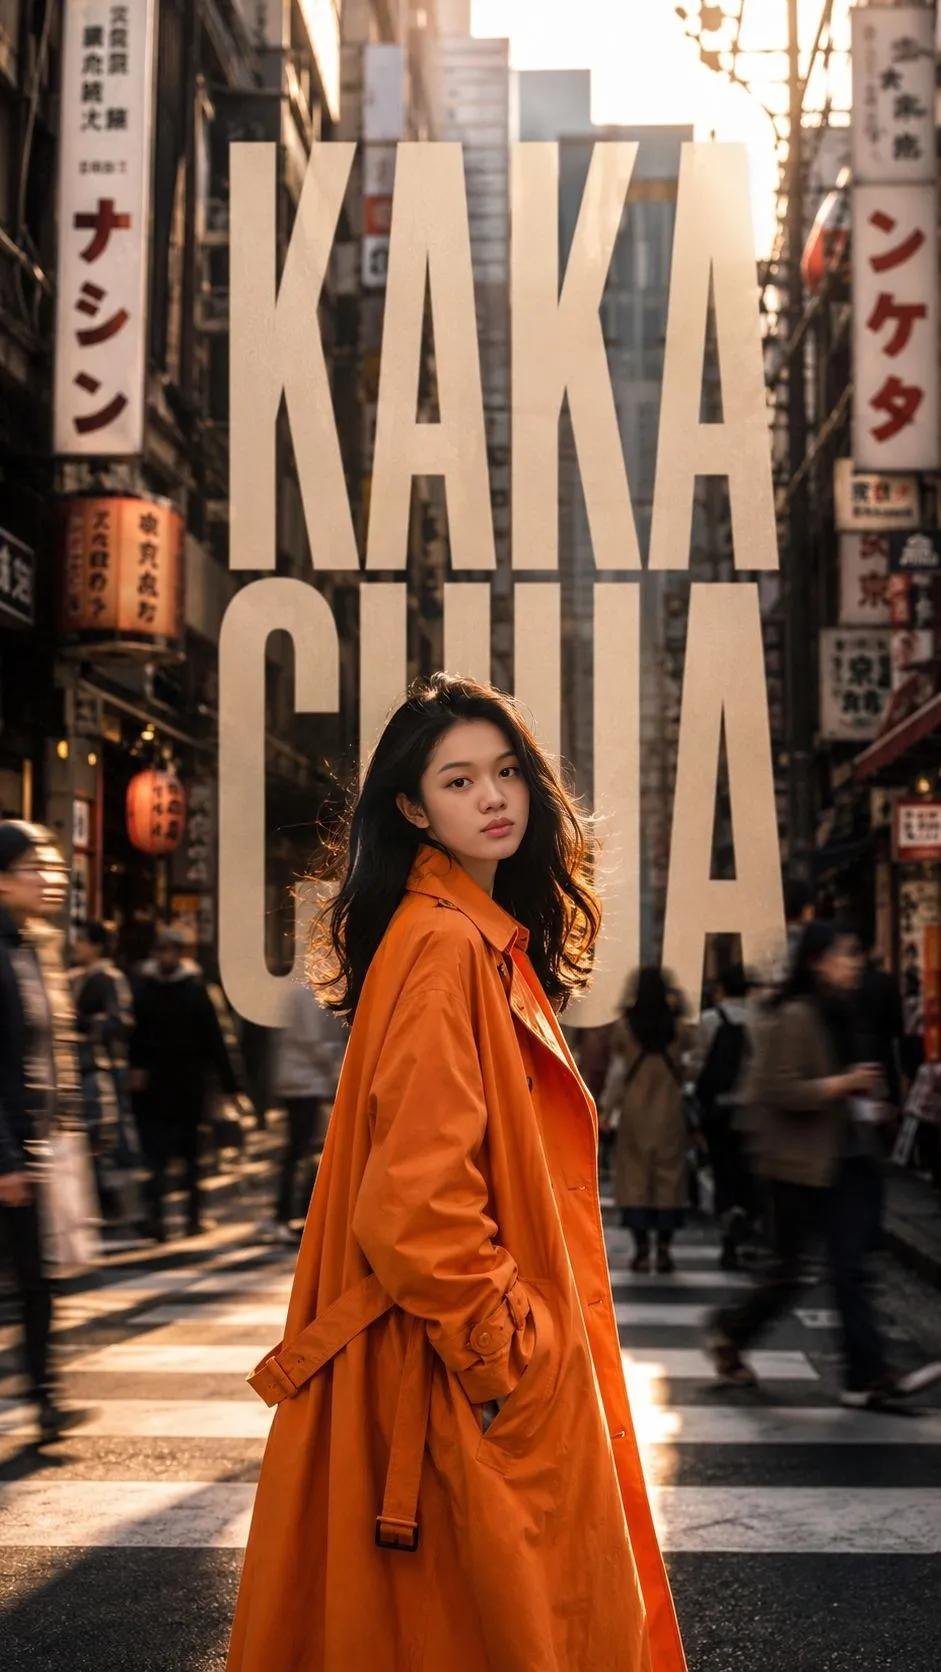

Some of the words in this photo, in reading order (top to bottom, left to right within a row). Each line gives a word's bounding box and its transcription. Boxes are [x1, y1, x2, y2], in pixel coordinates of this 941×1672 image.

[73, 197, 132, 435] ナシン
[865, 210, 929, 443] ンケタ
